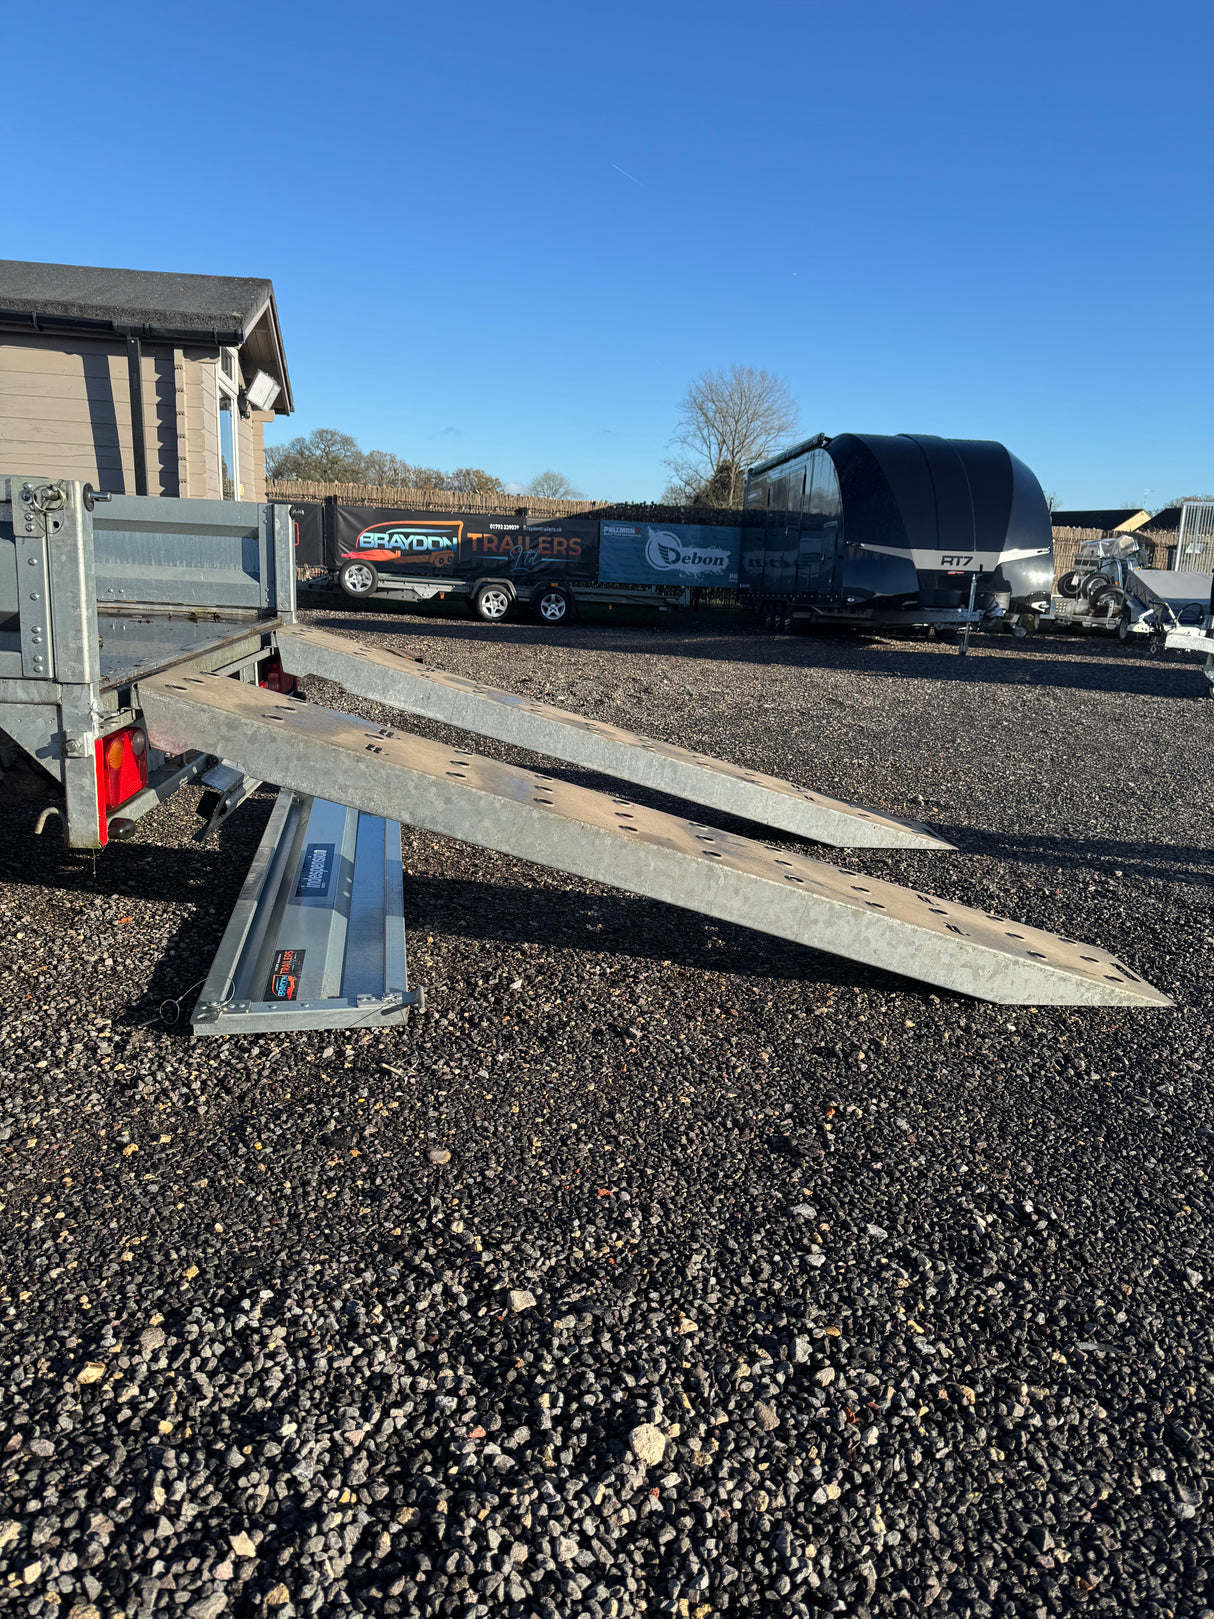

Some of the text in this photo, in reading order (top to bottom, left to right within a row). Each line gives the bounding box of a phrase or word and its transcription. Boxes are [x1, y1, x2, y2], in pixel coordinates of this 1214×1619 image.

[359, 532, 582, 556] BRAYDON TRAILERS
[658, 542, 724, 567] Debon
[510, 544, 540, 572] Ltd
[941, 555, 973, 566] RT7
